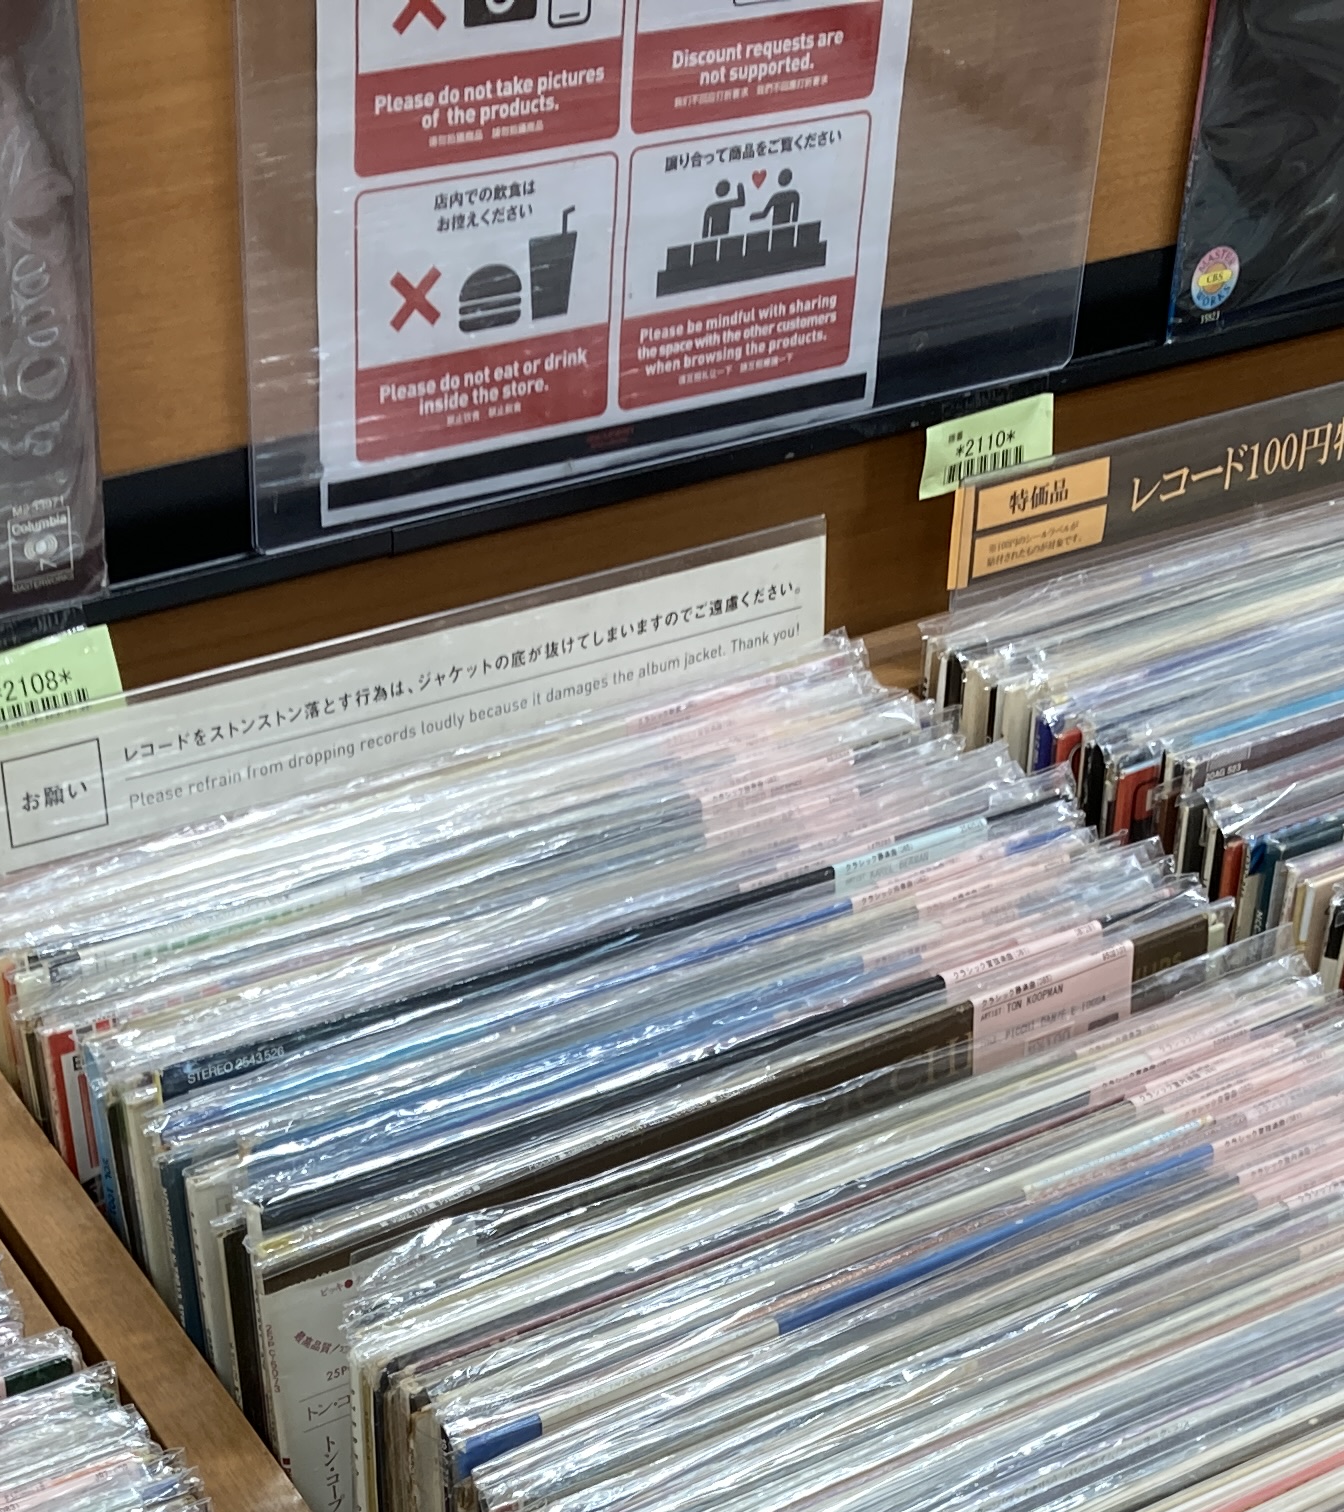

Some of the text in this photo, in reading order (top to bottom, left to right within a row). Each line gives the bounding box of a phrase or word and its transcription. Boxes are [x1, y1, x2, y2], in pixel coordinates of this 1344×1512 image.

[671, 30, 844, 69] Discount requests are
[699, 52, 815, 86] not supported.
[374, 66, 605, 115] Please do not take pictures
[421, 96, 559, 129] of the products.
[664, 129, 843, 173] 譲り合って商品をご覧ください
[433, 180, 537, 211] 店内での飲食は
[436, 203, 534, 233] お控えください
[637, 311, 837, 361] the space with the other customers
[640, 294, 838, 344] Please be mindful with sharing
[645, 358, 681, 377] when
[684, 344, 742, 369] browsing
[746, 339, 766, 356] the
[768, 332, 827, 355] products.
[379, 347, 588, 404] Please do not eat or drink
[419, 390, 468, 416] inside
[472, 384, 498, 405] the
[502, 377, 549, 400] store.
[1009, 477, 1069, 514] 特価品
[12, 513, 67, 536] Columbia
[128, 623, 800, 810] Please refrain from dropping records loudly because it damages the album jacket. Thank you!
[21, 782, 88, 811] お願い
[1026, 984, 1064, 1005] KOOPMAN
[187, 1059, 233, 1085] STEREO
